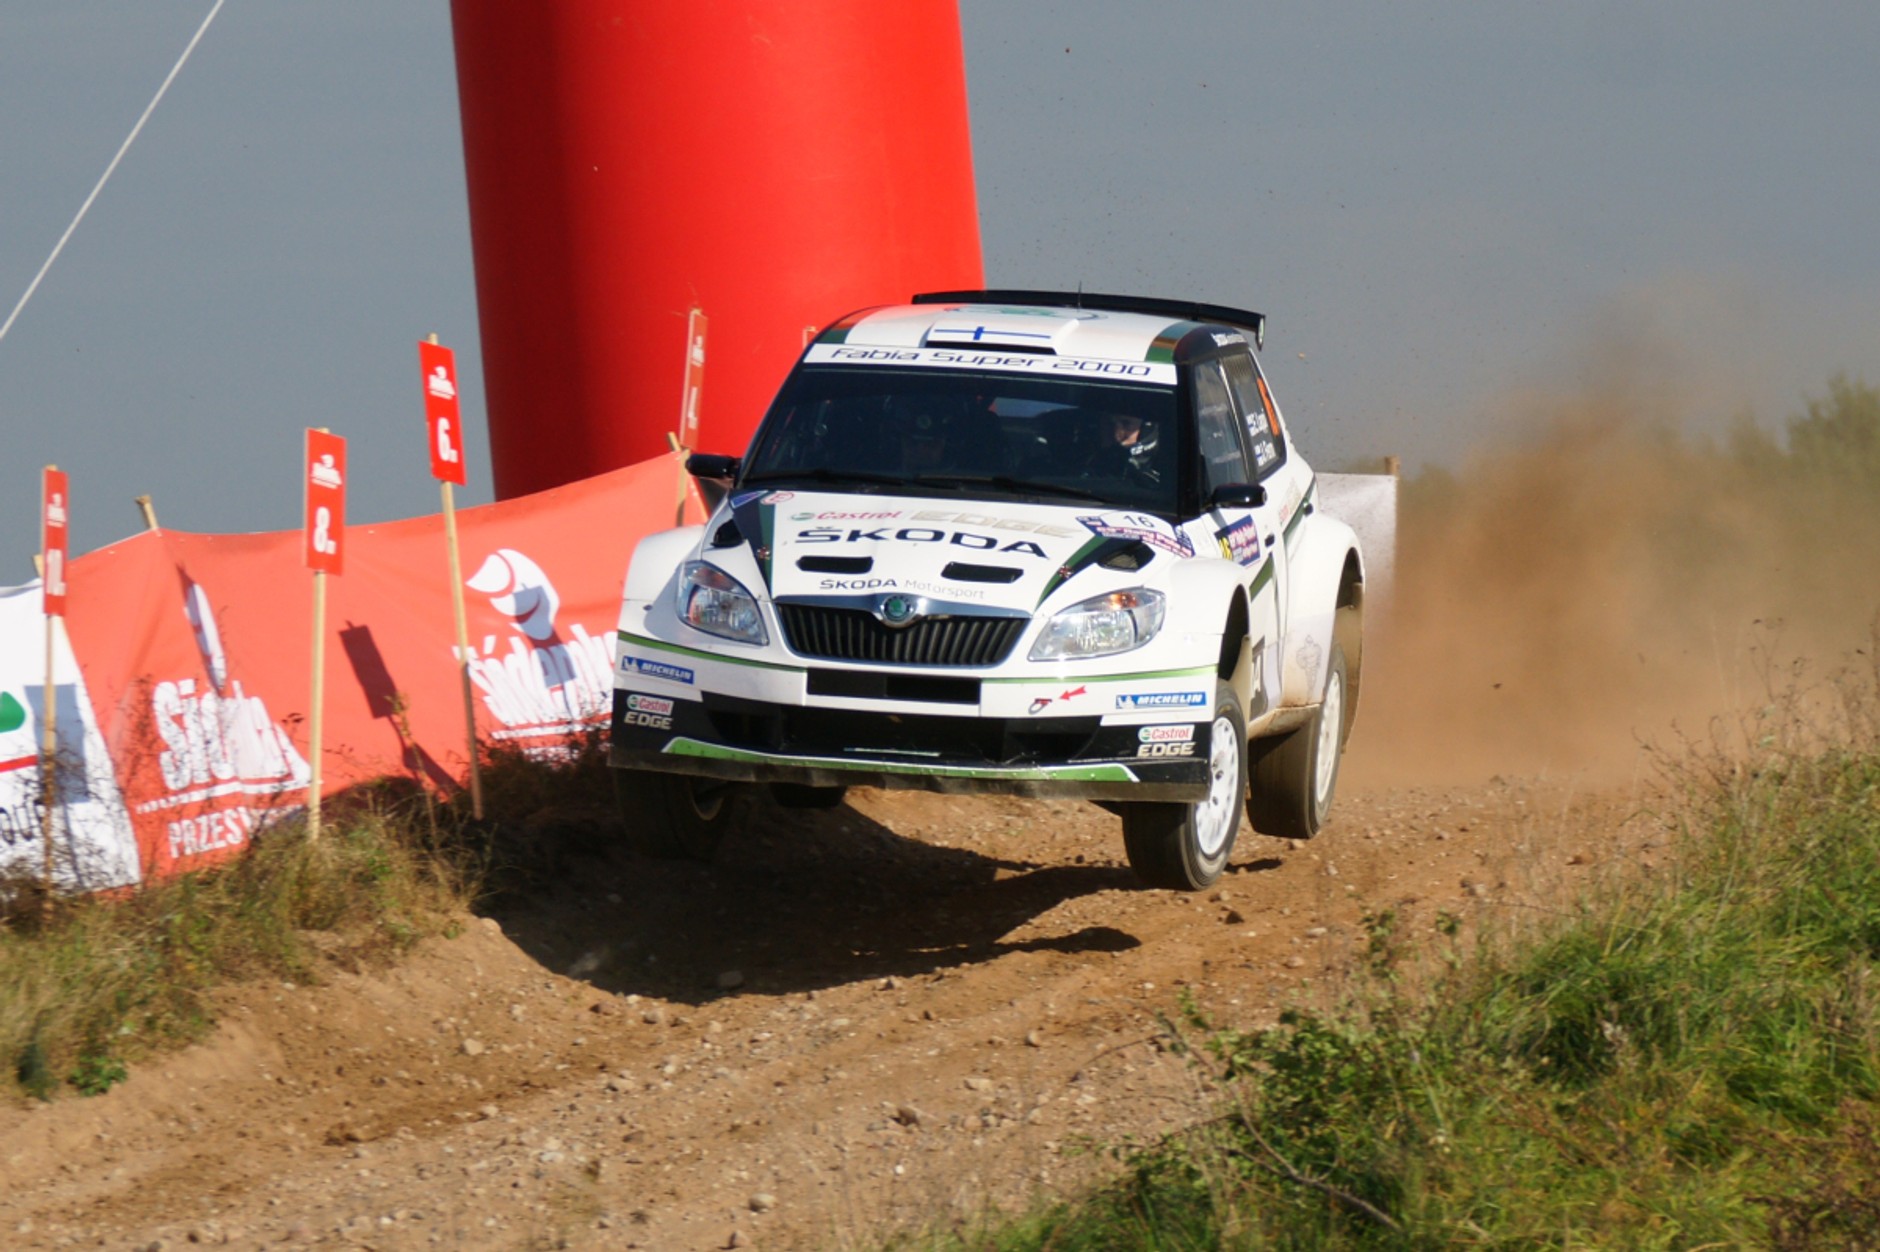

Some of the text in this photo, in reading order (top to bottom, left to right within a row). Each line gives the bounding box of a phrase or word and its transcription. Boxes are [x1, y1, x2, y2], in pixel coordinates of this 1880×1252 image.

[831, 348, 1152, 377] Fabia Super 2000
[817, 511, 902, 521] Castrol
[1124, 514, 1155, 528] 16
[794, 526, 1050, 560] ŠKODA
[820, 579, 985, 599] ŠKODA Motorsport
[641, 662, 692, 680] MICHELIN
[639, 697, 671, 713] Castrol
[1137, 693, 1203, 705] MICHELIN
[624, 711, 673, 730] EDGE
[1151, 727, 1190, 740] Castrol
[1137, 741, 1197, 757] EDGE
